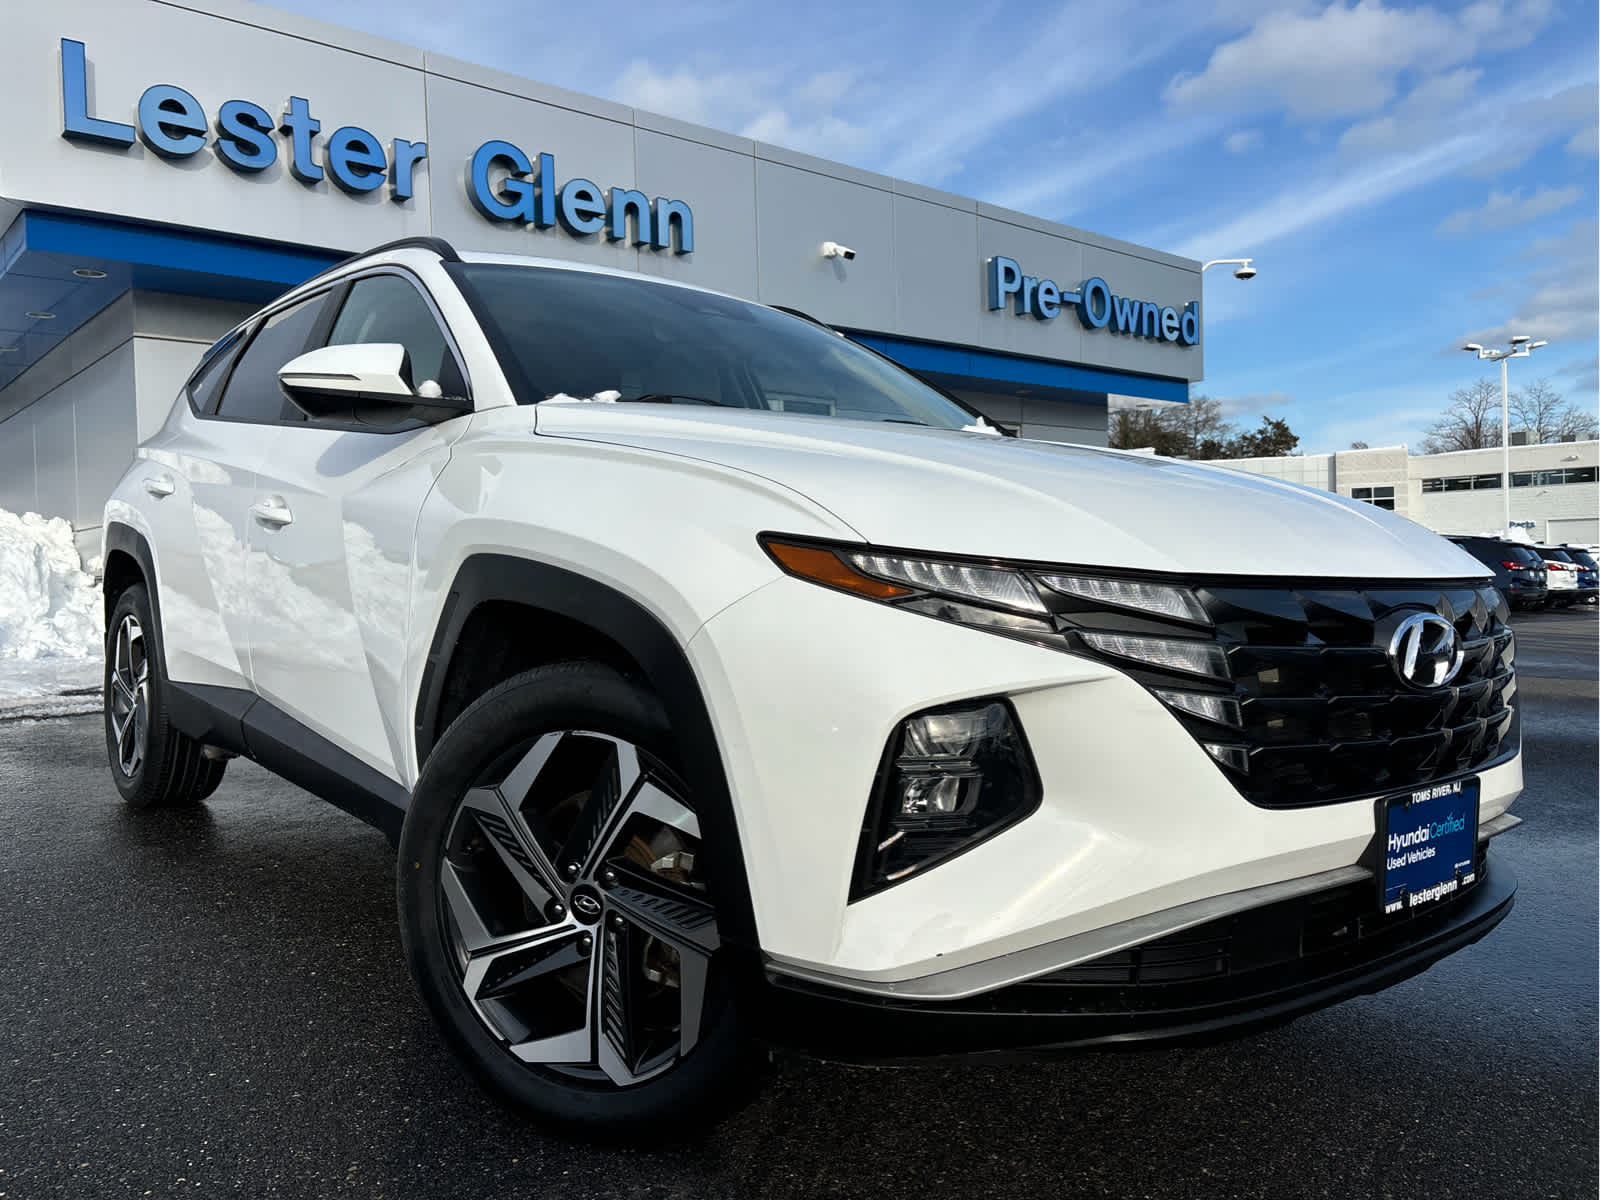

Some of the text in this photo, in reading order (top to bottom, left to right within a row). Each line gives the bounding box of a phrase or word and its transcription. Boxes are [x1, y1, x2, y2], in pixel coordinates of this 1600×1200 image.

[60, 38, 694, 254] Lester Glenn
[987, 255, 1200, 346] Pre-Owned
[1411, 789, 1431, 804] TOMS
[1452, 781, 1462, 793] NJ
[1386, 852, 1406, 870] Used
[1407, 846, 1436, 865] Vehicles
[1409, 879, 1458, 907] lesterglenn
